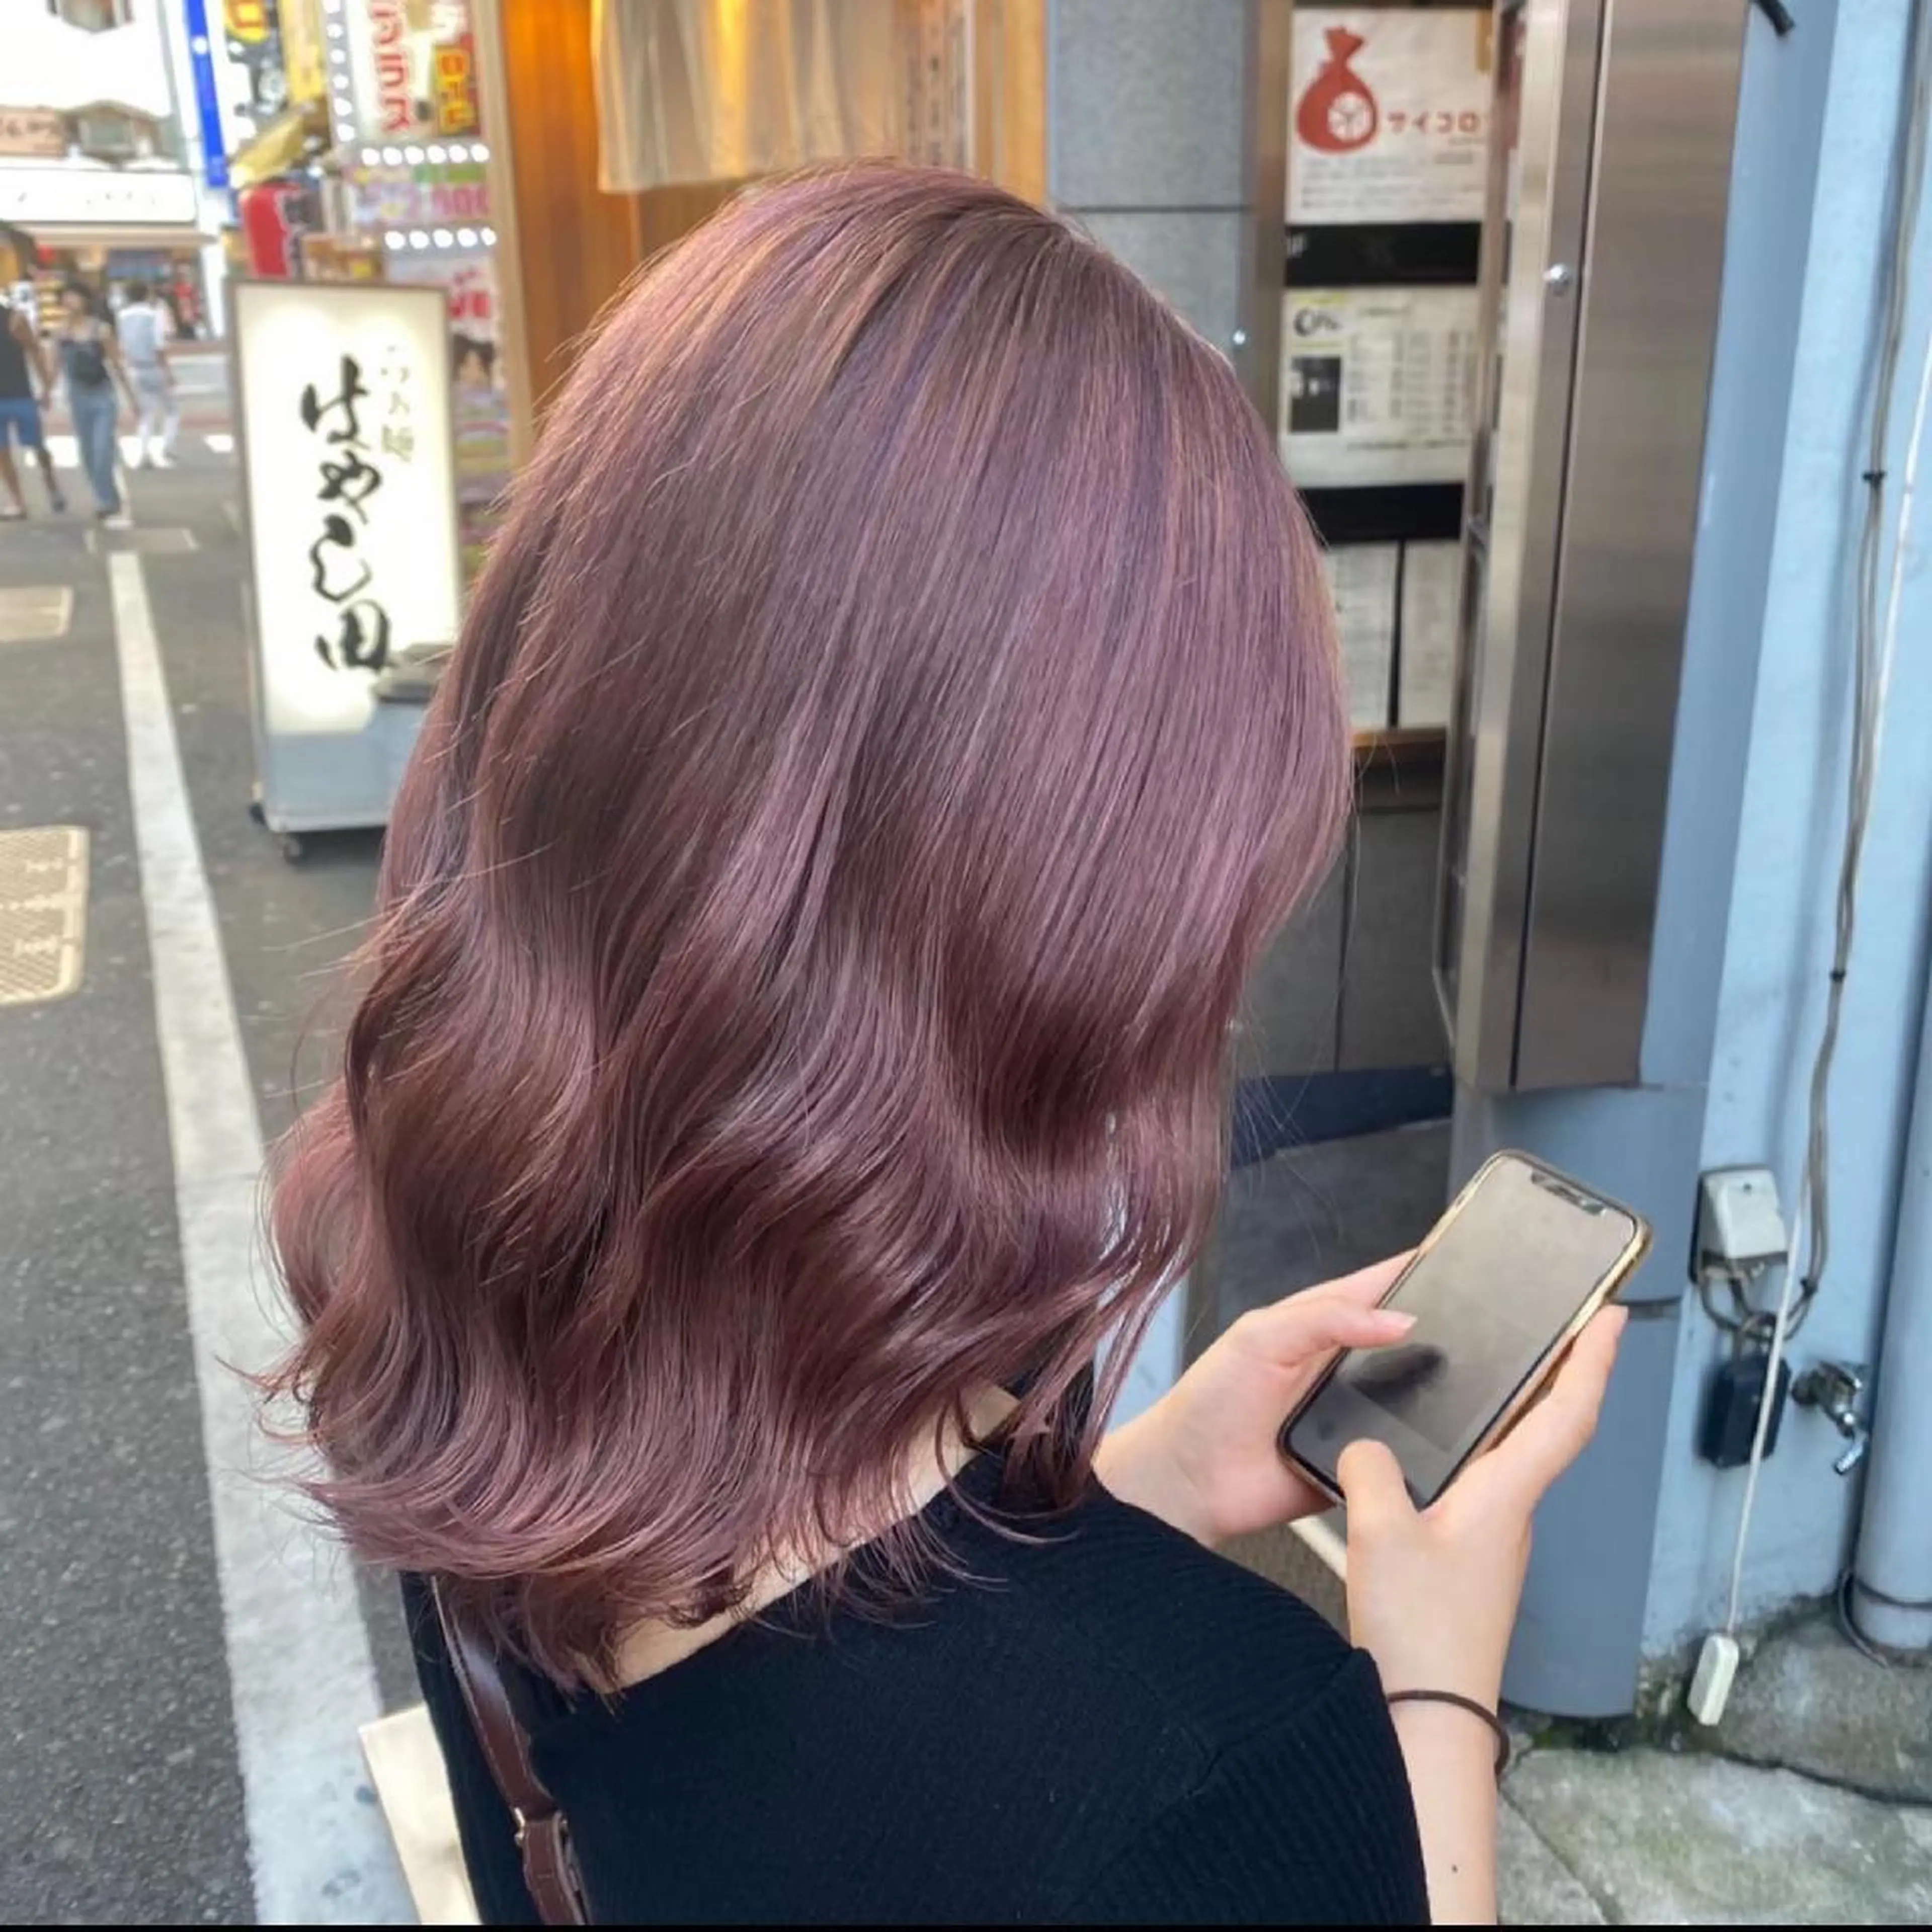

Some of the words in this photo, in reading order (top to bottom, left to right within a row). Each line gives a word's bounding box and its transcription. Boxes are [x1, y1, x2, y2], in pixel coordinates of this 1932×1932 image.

[1387, 109, 1481, 135] サイコロ
[300, 353, 391, 673] はやし田
